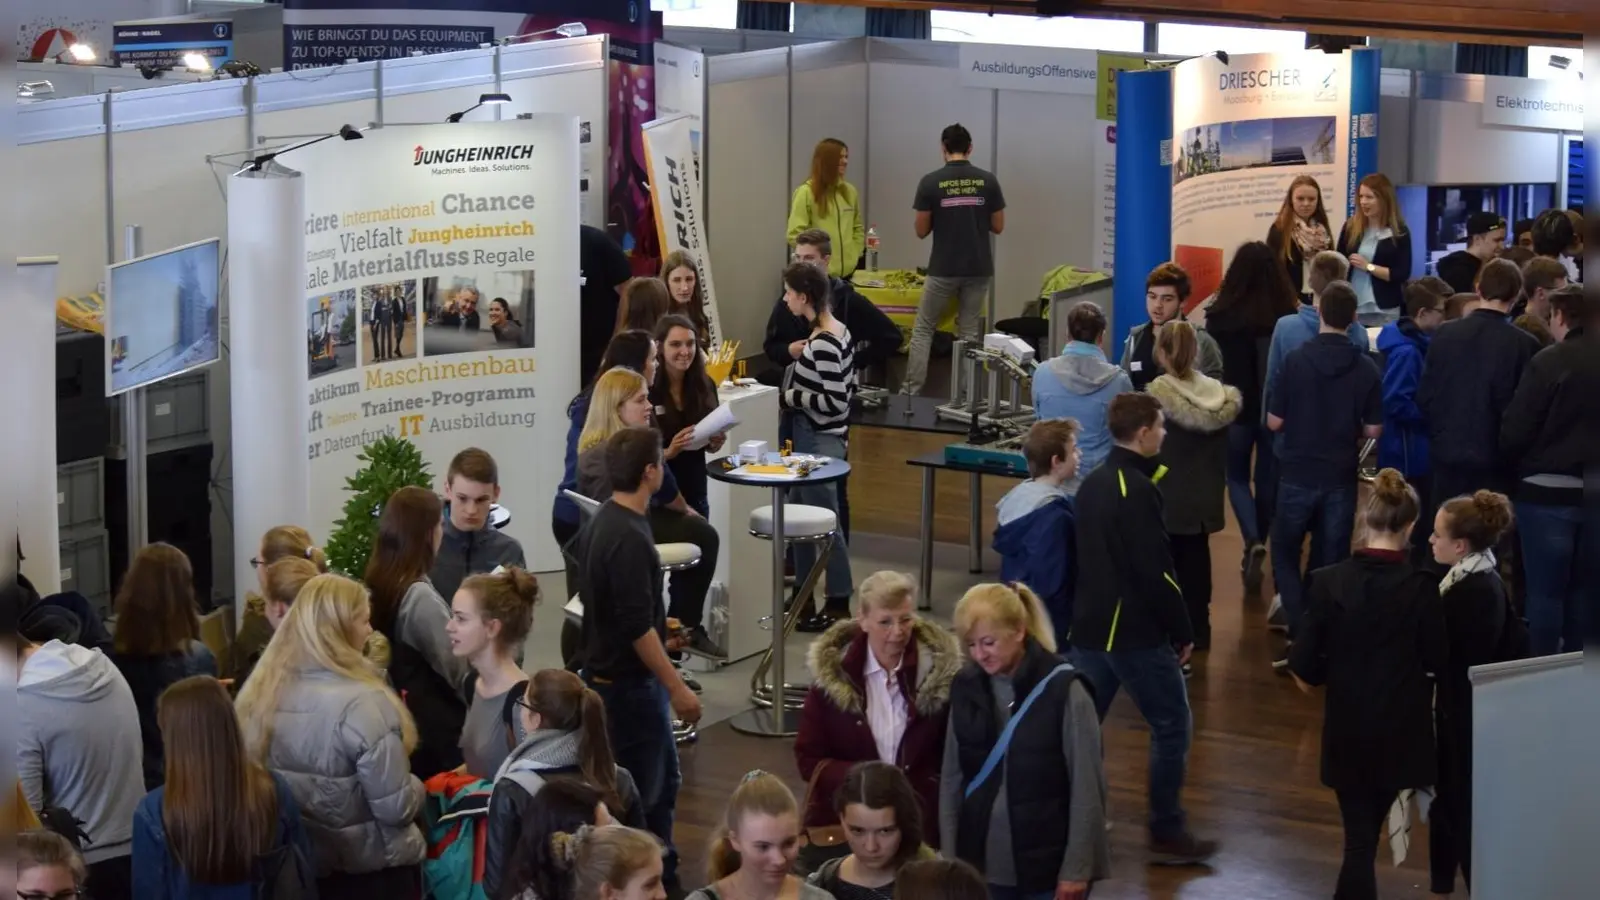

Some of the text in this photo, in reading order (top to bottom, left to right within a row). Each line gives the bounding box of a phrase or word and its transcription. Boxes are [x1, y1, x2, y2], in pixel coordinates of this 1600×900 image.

[291, 29, 485, 43] WIE BRINGST DU DAS EQUIPMENT
[291, 46, 308, 58] ZU
[311, 45, 386, 58] TOP-EVENTS?
[389, 46, 403, 57] IN
[972, 60, 1097, 79] AusbildungsOffensive
[1219, 68, 1302, 91] DRIESCHER
[413, 144, 534, 166] JUNGHEINRICH
[492, 163, 532, 172] Solutions.
[442, 192, 535, 215] Chance
[679, 157, 700, 250] Solutions.
[340, 226, 404, 254] Vielfalt
[408, 219, 535, 245] Jungheinrich
[332, 249, 469, 284] Materialfluss
[473, 247, 535, 267] Regale
[363, 354, 536, 391] Maschinenbau
[361, 386, 535, 418] Trainee-Programm
[324, 423, 396, 455] Datenfunk
[399, 414, 424, 437] IT
[428, 410, 536, 434] Ausbildung
